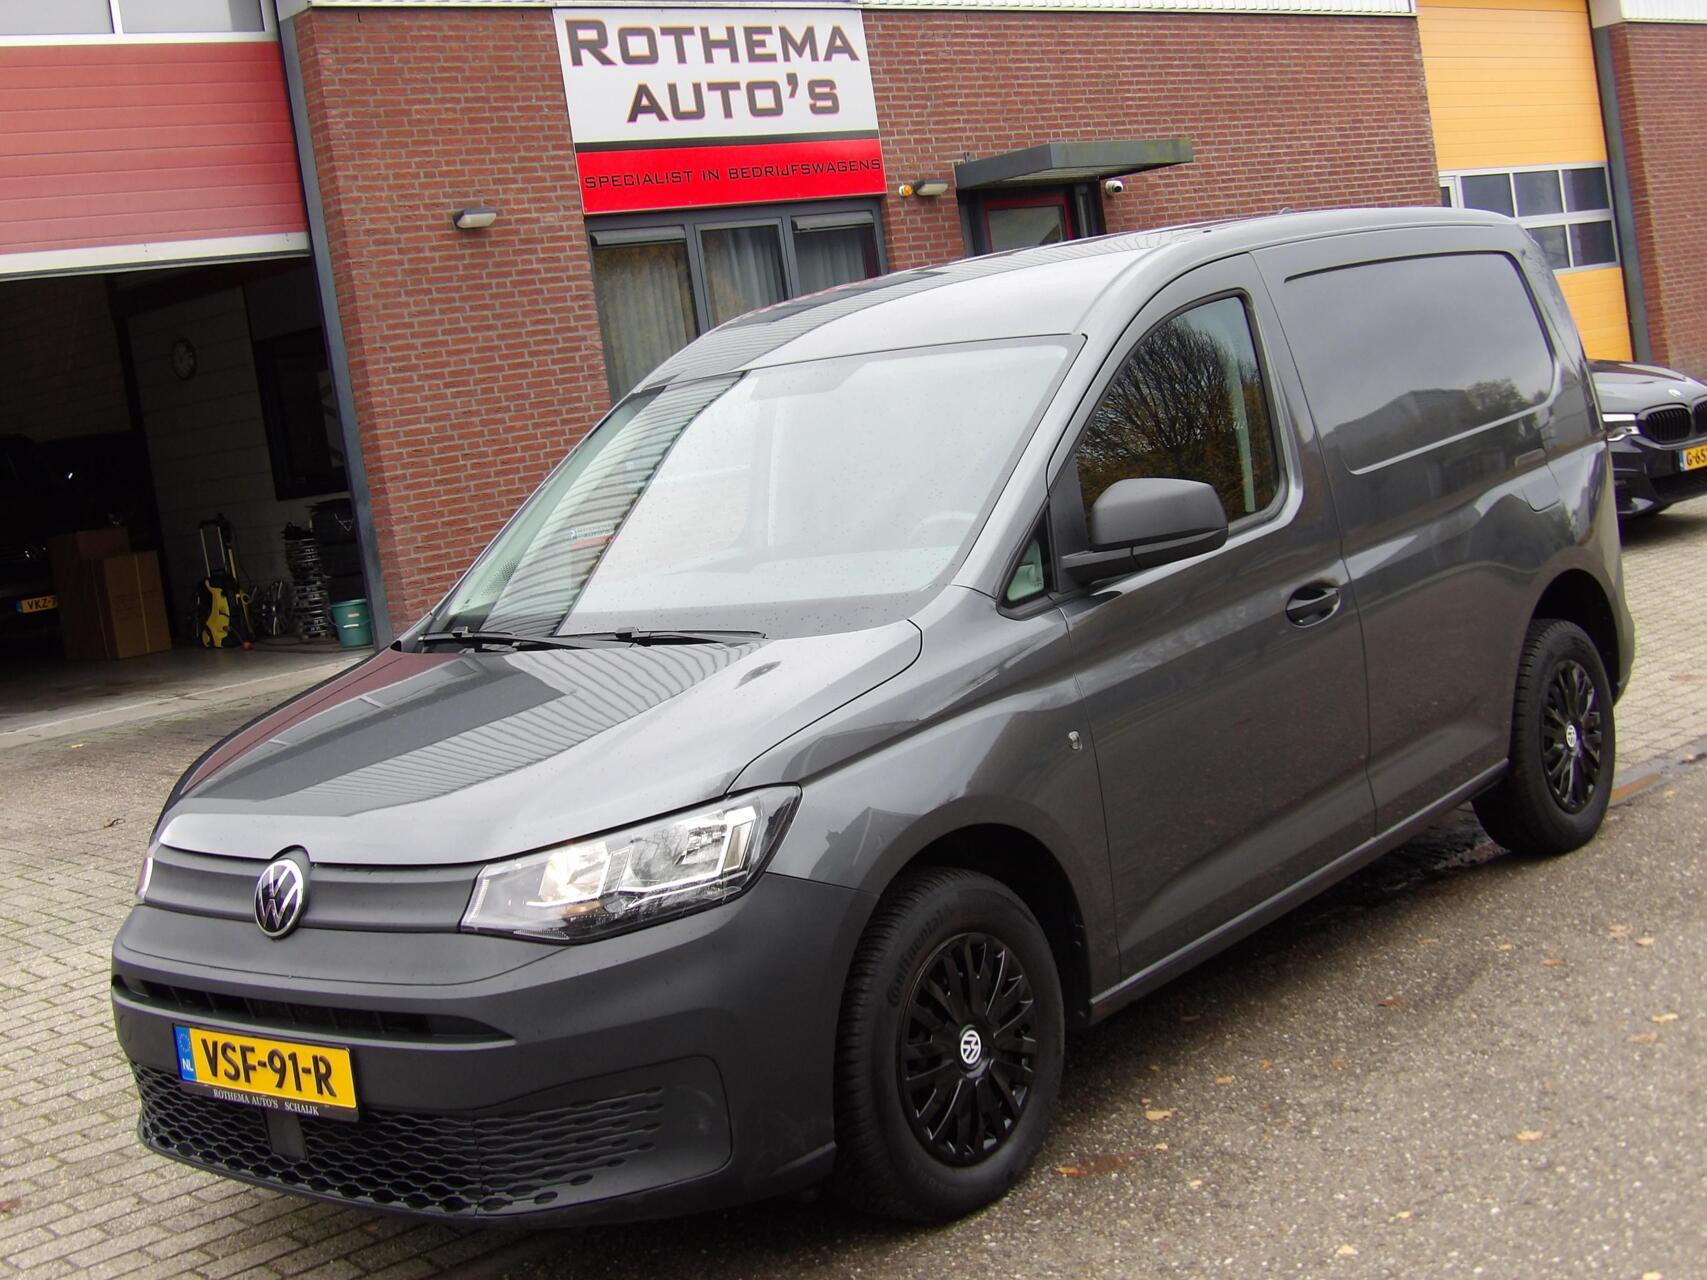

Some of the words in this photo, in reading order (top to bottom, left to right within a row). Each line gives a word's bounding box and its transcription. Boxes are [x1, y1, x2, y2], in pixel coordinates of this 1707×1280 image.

[565, 18, 860, 66] ROTHEMA
[626, 72, 840, 123] AUTO'S
[585, 170, 693, 189] SPECIALIST
[702, 169, 720, 181] IN
[729, 158, 881, 180] BEDRIJFSWAGENS
[1687, 448, 1707, 466] G-65
[182, 1058, 194, 1072] NL
[201, 1038, 337, 1097] VSF-91-R
[213, 1088, 250, 1104] ROTHEMA
[251, 1095, 278, 1109] AUTO'S
